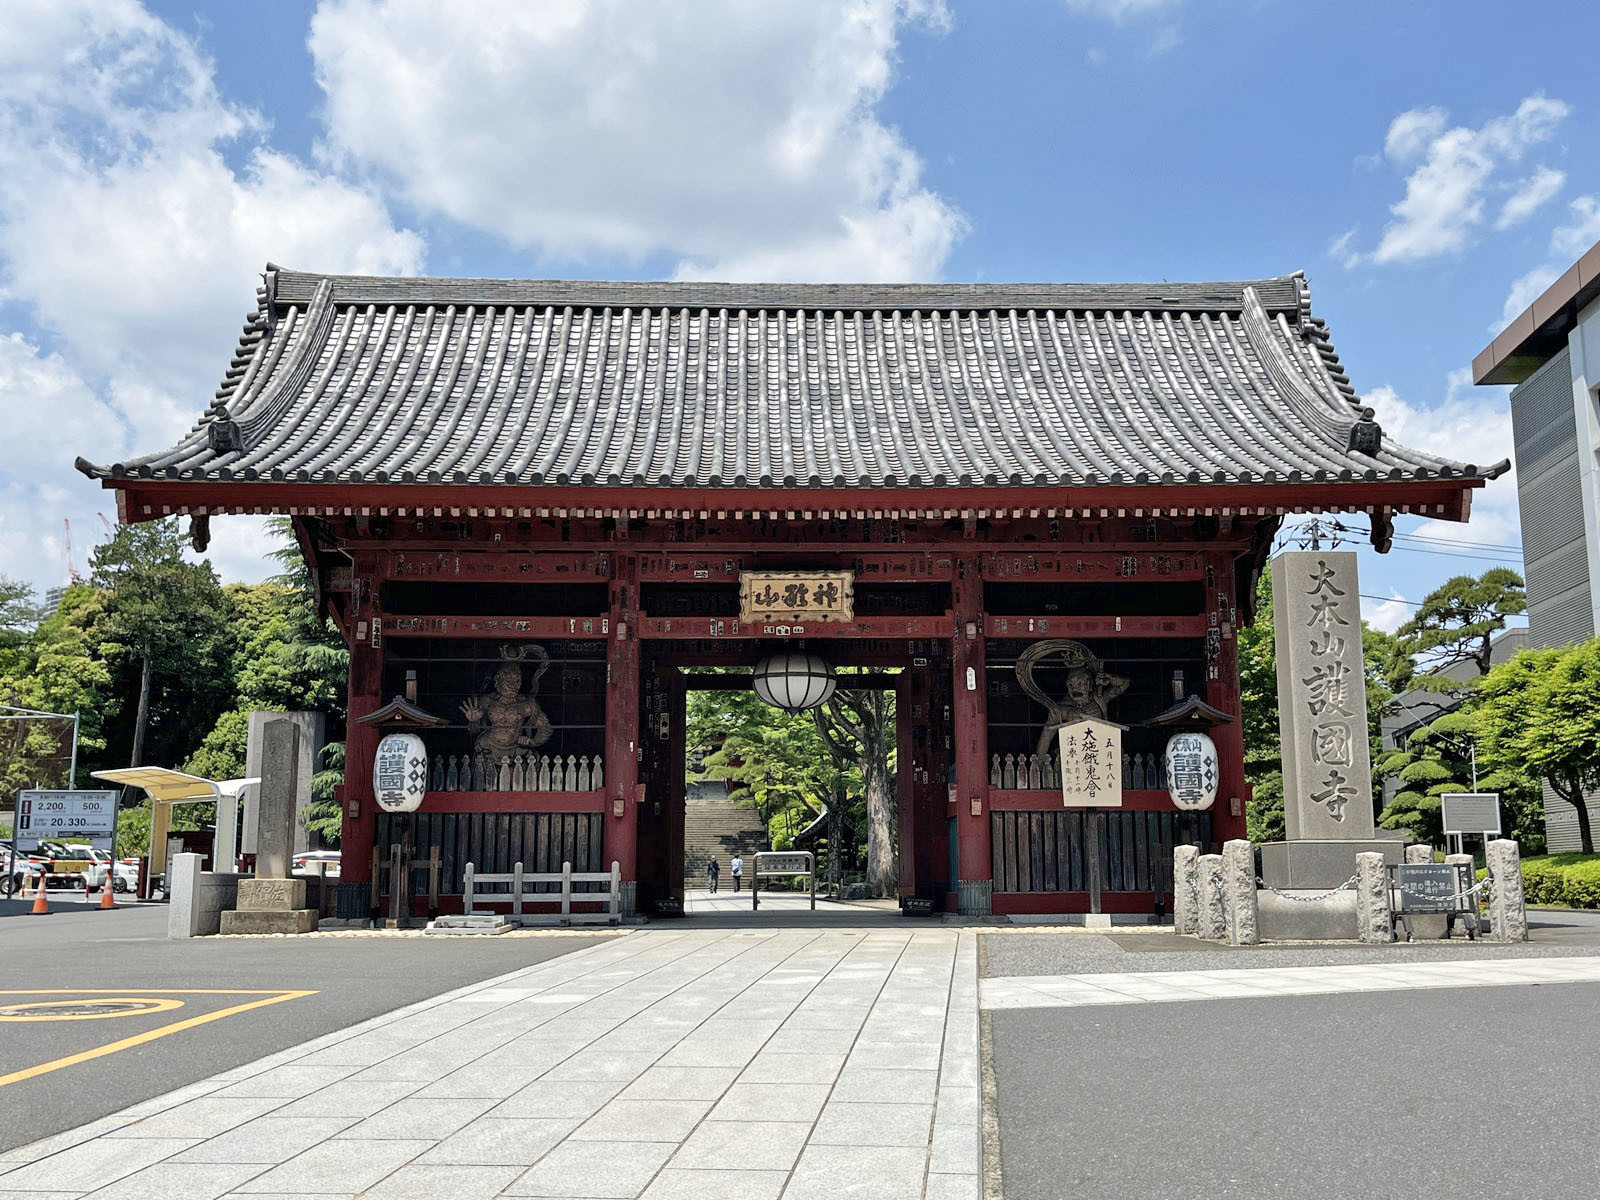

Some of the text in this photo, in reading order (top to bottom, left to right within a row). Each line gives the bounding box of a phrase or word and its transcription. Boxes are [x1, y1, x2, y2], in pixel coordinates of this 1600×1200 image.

[1105, 738, 1116, 789] 五月十八日
[1302, 560, 1359, 823] 大本山護國寺
